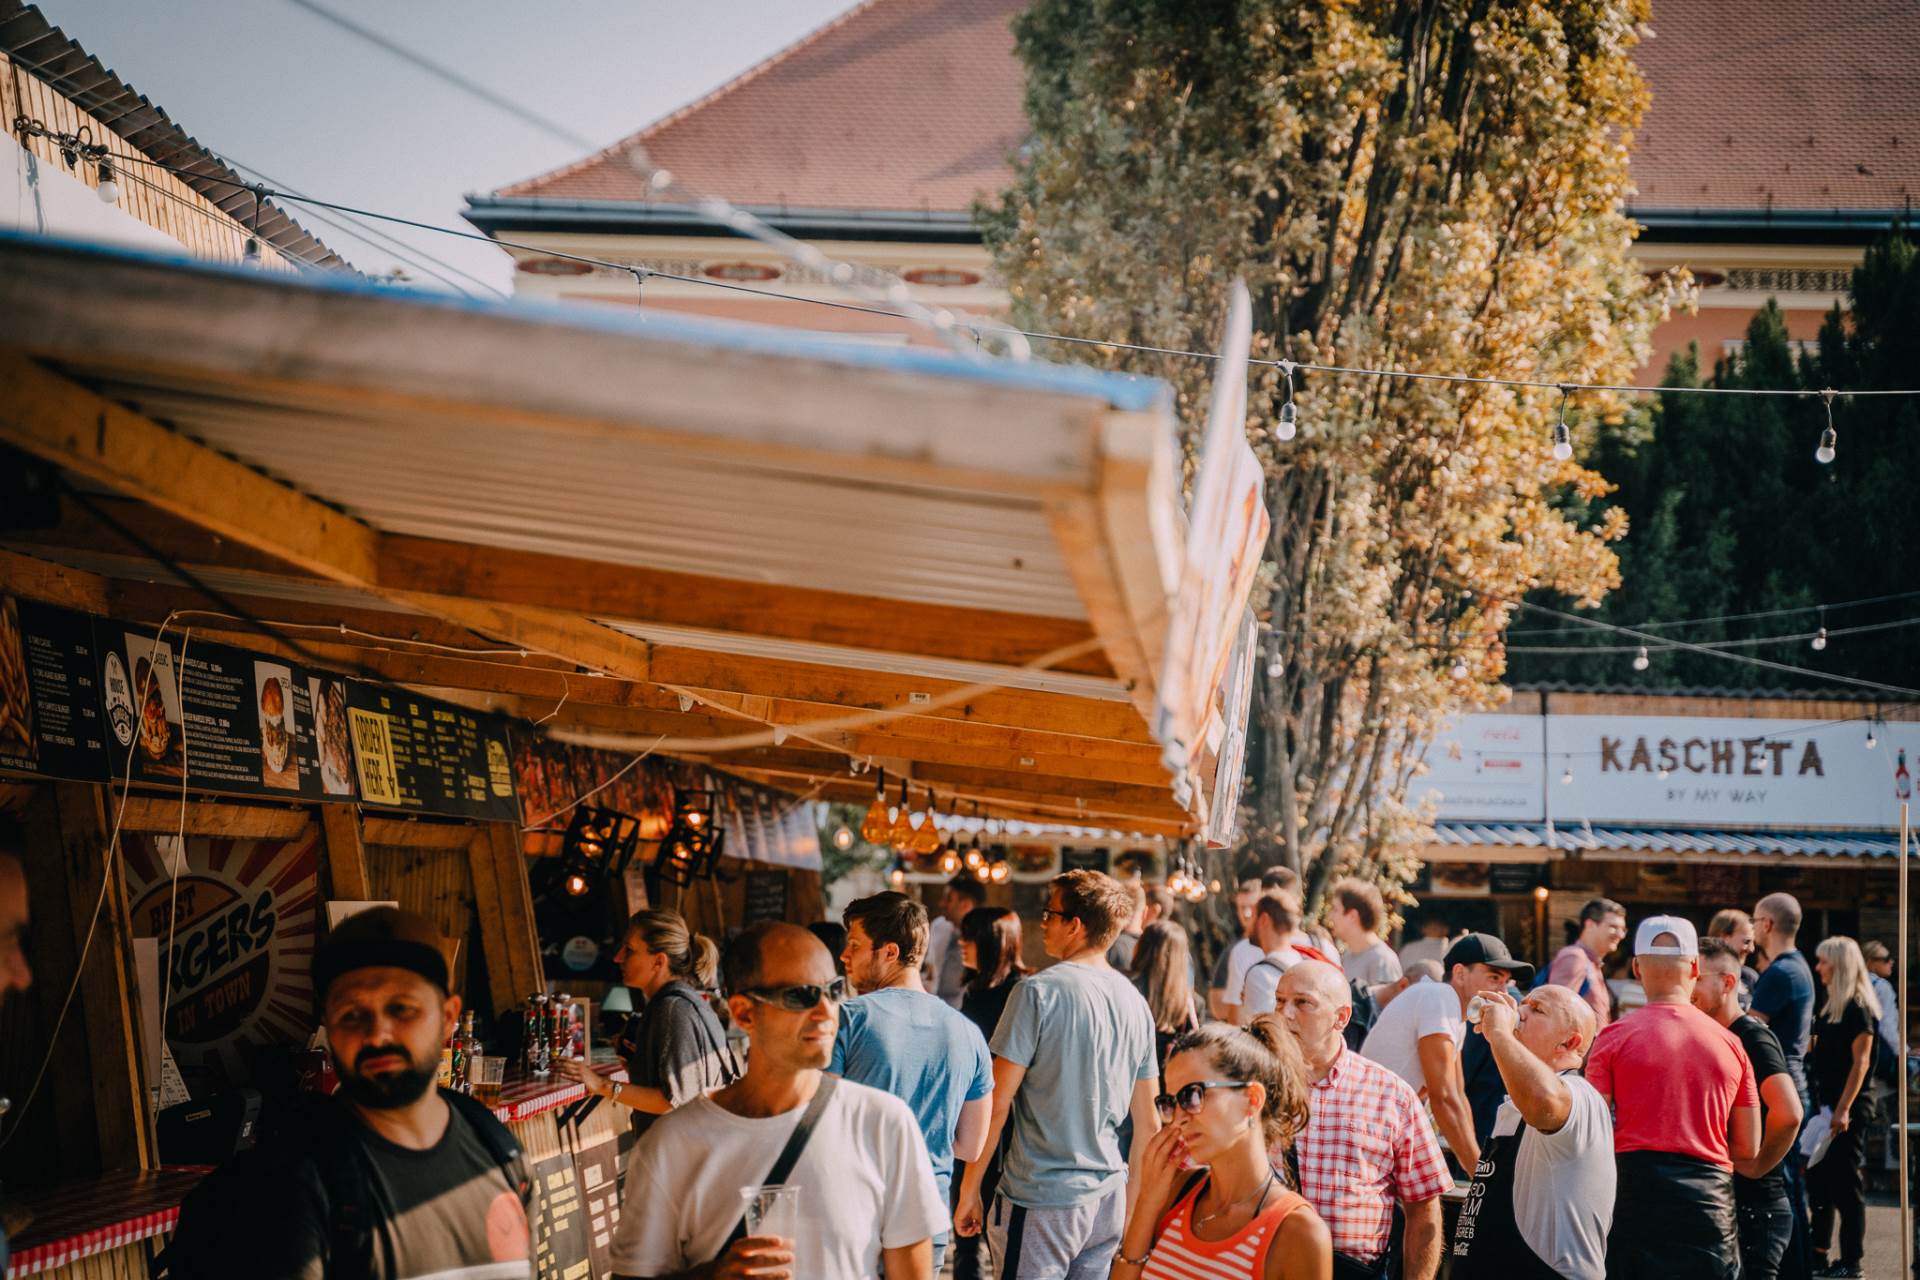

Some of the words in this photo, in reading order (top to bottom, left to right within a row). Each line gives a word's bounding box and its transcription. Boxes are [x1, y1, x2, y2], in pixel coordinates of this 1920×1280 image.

[355, 714, 384, 755] ORDER
[362, 757, 385, 797] HERE
[1600, 735, 1825, 777] KASCHETA
[1667, 788, 1685, 801] BY
[1695, 789, 1720, 802] MY
[1730, 789, 1768, 803] WAY
[150, 884, 197, 934] BEST
[159, 890, 276, 997] RGERS
[177, 1001, 196, 1036] IN
[204, 973, 251, 1019] TOWN
